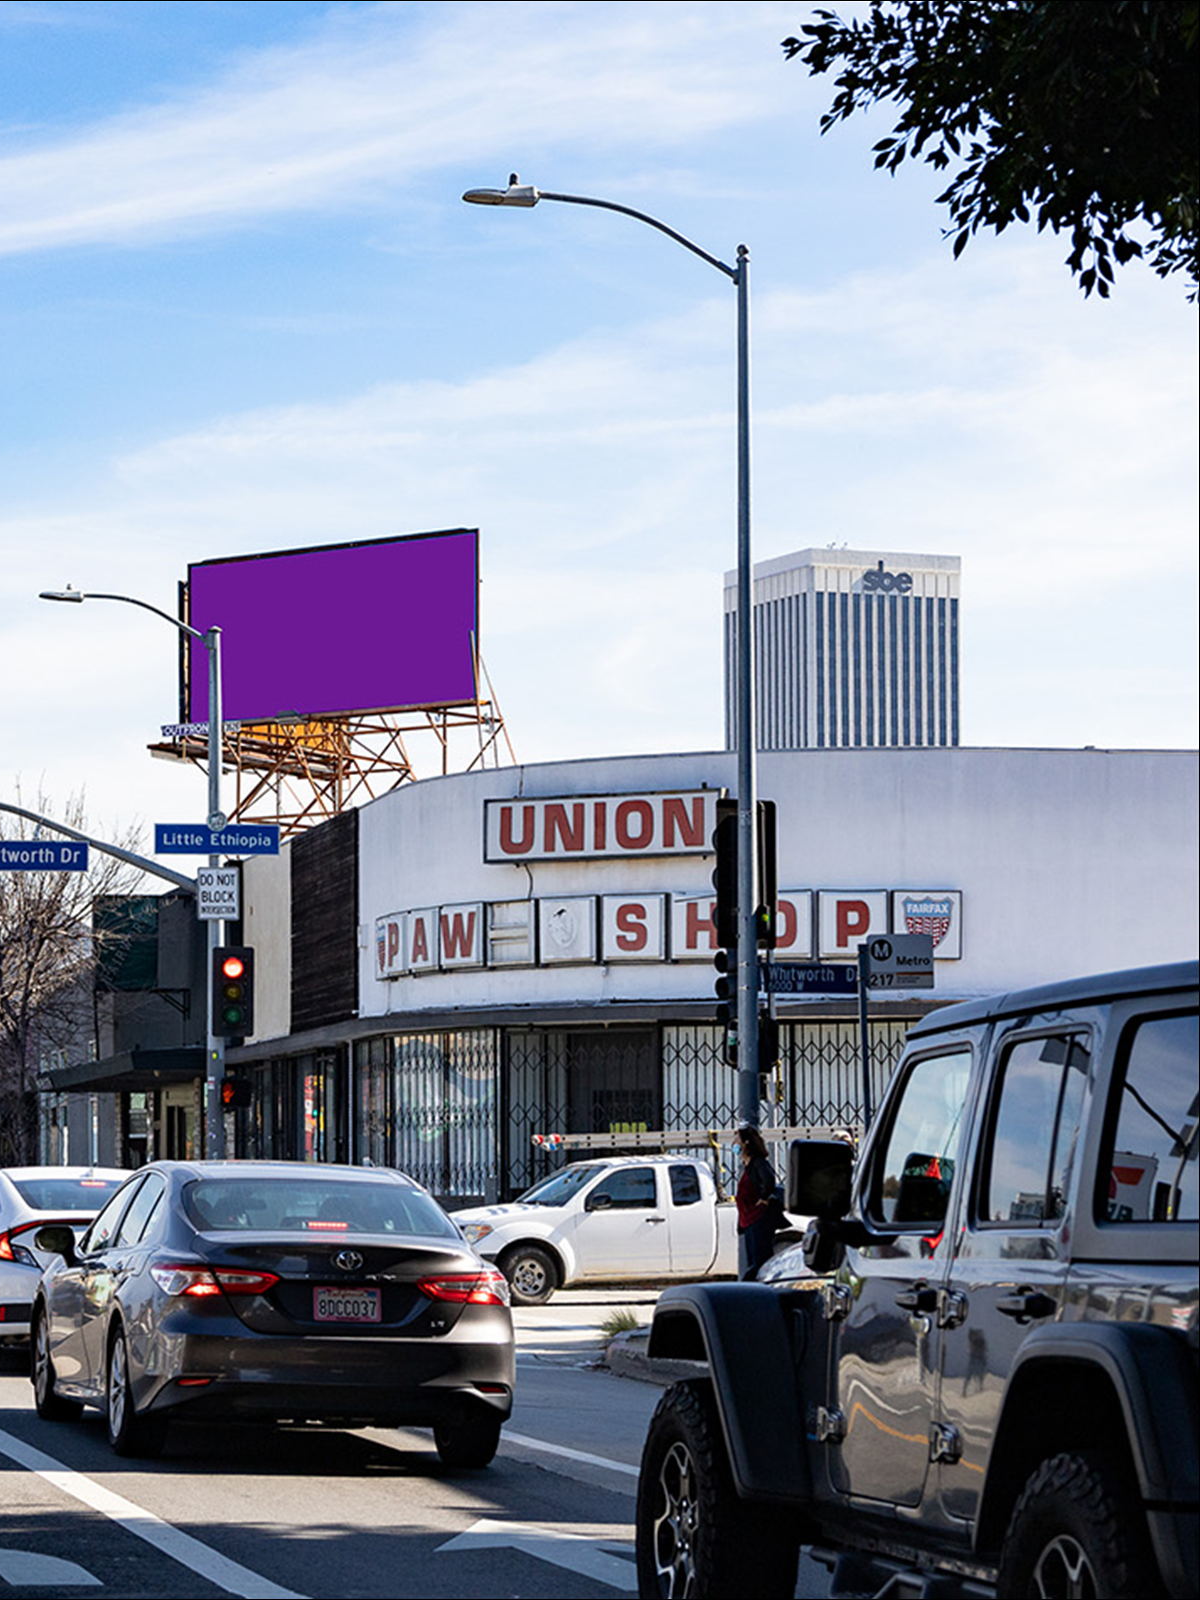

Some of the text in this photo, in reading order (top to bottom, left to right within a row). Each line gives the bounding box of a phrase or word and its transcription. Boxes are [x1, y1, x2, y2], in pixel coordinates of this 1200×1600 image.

[863, 560, 913, 593] sbe
[163, 722, 210, 736] OUTFRON
[500, 797, 704, 854] UNION
[163, 833, 271, 848] Little Ethiopia
[60, 848, 80, 863] Dr
[201, 874, 236, 886] DO NOT
[201, 891, 235, 903] BLOCK
[906, 902, 950, 915] FAIRFAX
[388, 900, 870, 967] PAW SHOP
[896, 956, 931, 966] Metro
[768, 967, 858, 982] Whitworth D
[870, 974, 894, 986] 217
